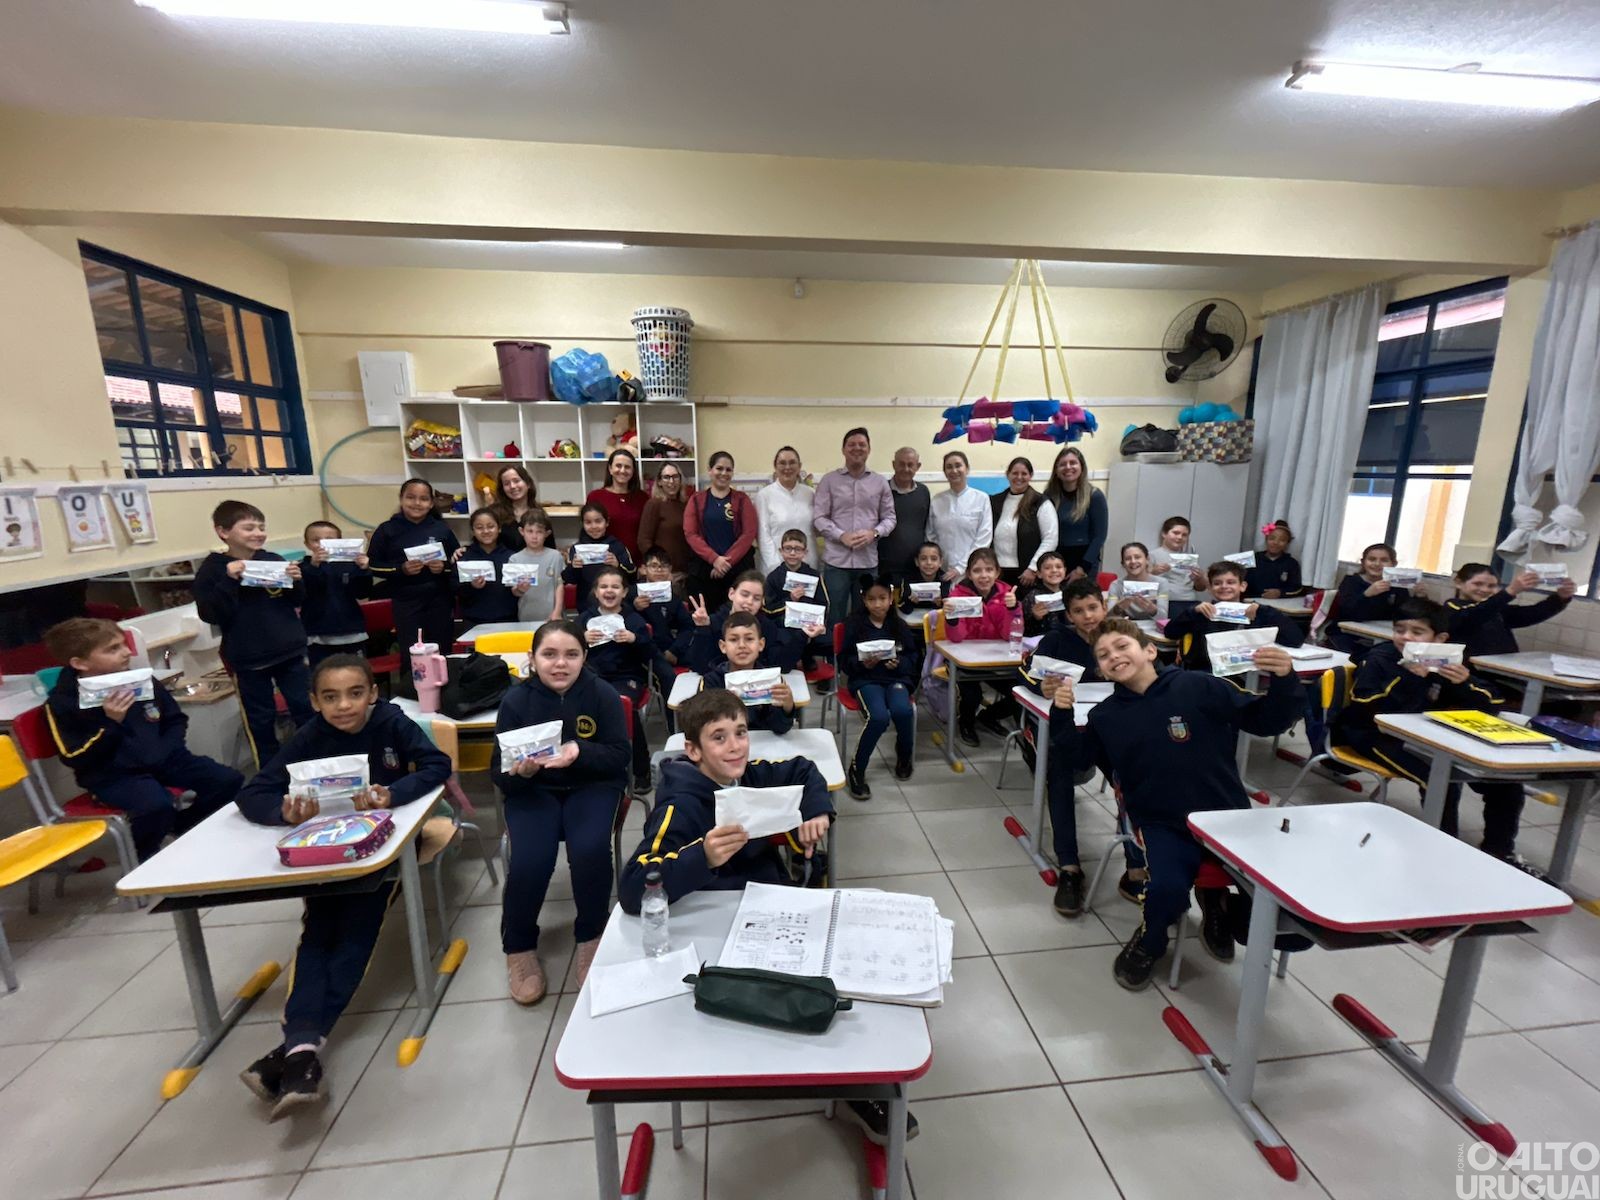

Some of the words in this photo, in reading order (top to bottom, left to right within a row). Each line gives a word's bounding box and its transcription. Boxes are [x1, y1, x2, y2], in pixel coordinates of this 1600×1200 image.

[4, 497, 12, 515] I
[71, 495, 86, 511] O
[121, 492, 134, 507] U
